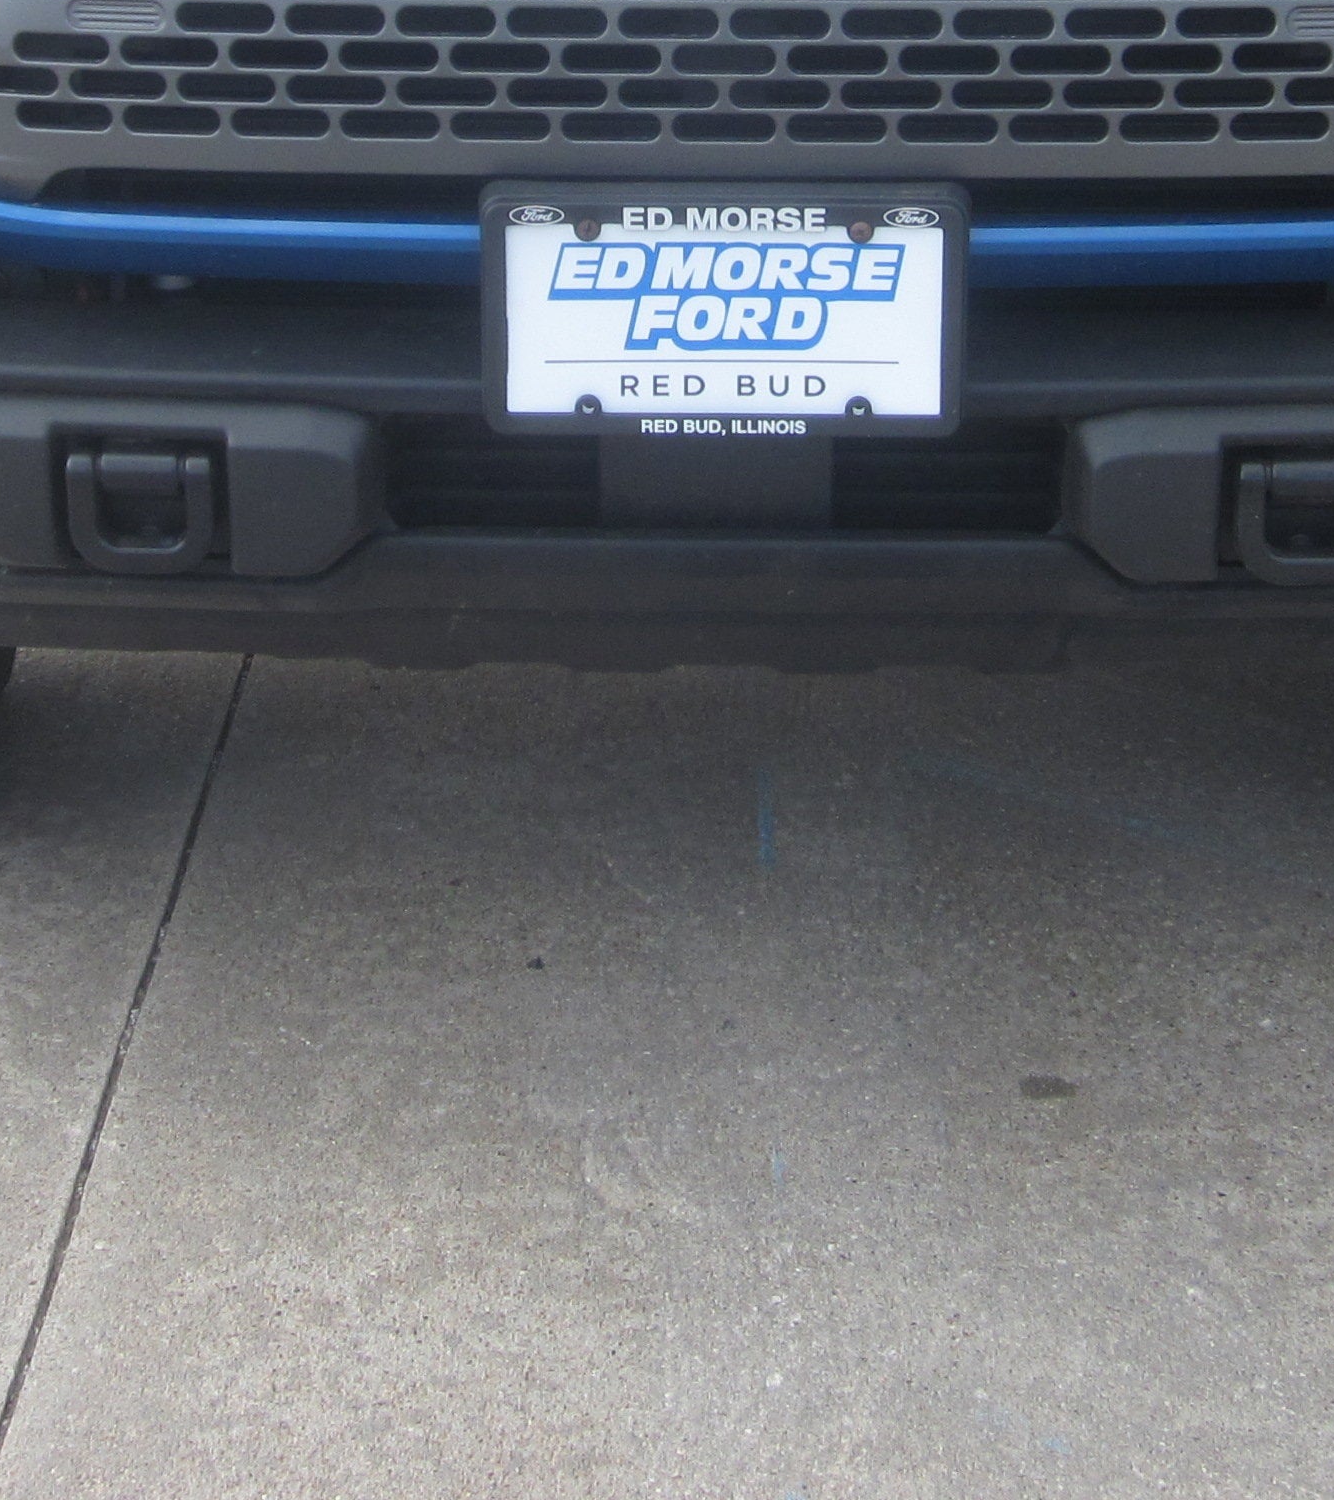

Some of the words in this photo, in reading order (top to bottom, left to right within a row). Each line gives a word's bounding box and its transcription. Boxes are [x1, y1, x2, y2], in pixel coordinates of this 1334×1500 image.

[520, 206, 555, 223] Ford
[623, 206, 673, 231] ED
[686, 207, 827, 232] MORSE
[894, 210, 928, 225] Ford
[554, 246, 647, 290] ED
[651, 246, 900, 291] MORSE
[632, 295, 823, 341] FORD
[620, 374, 706, 397] RED
[736, 374, 827, 397] BUD
[640, 419, 678, 434] RED
[683, 419, 727, 437] BUD,
[731, 419, 807, 434] ILLINOIS
